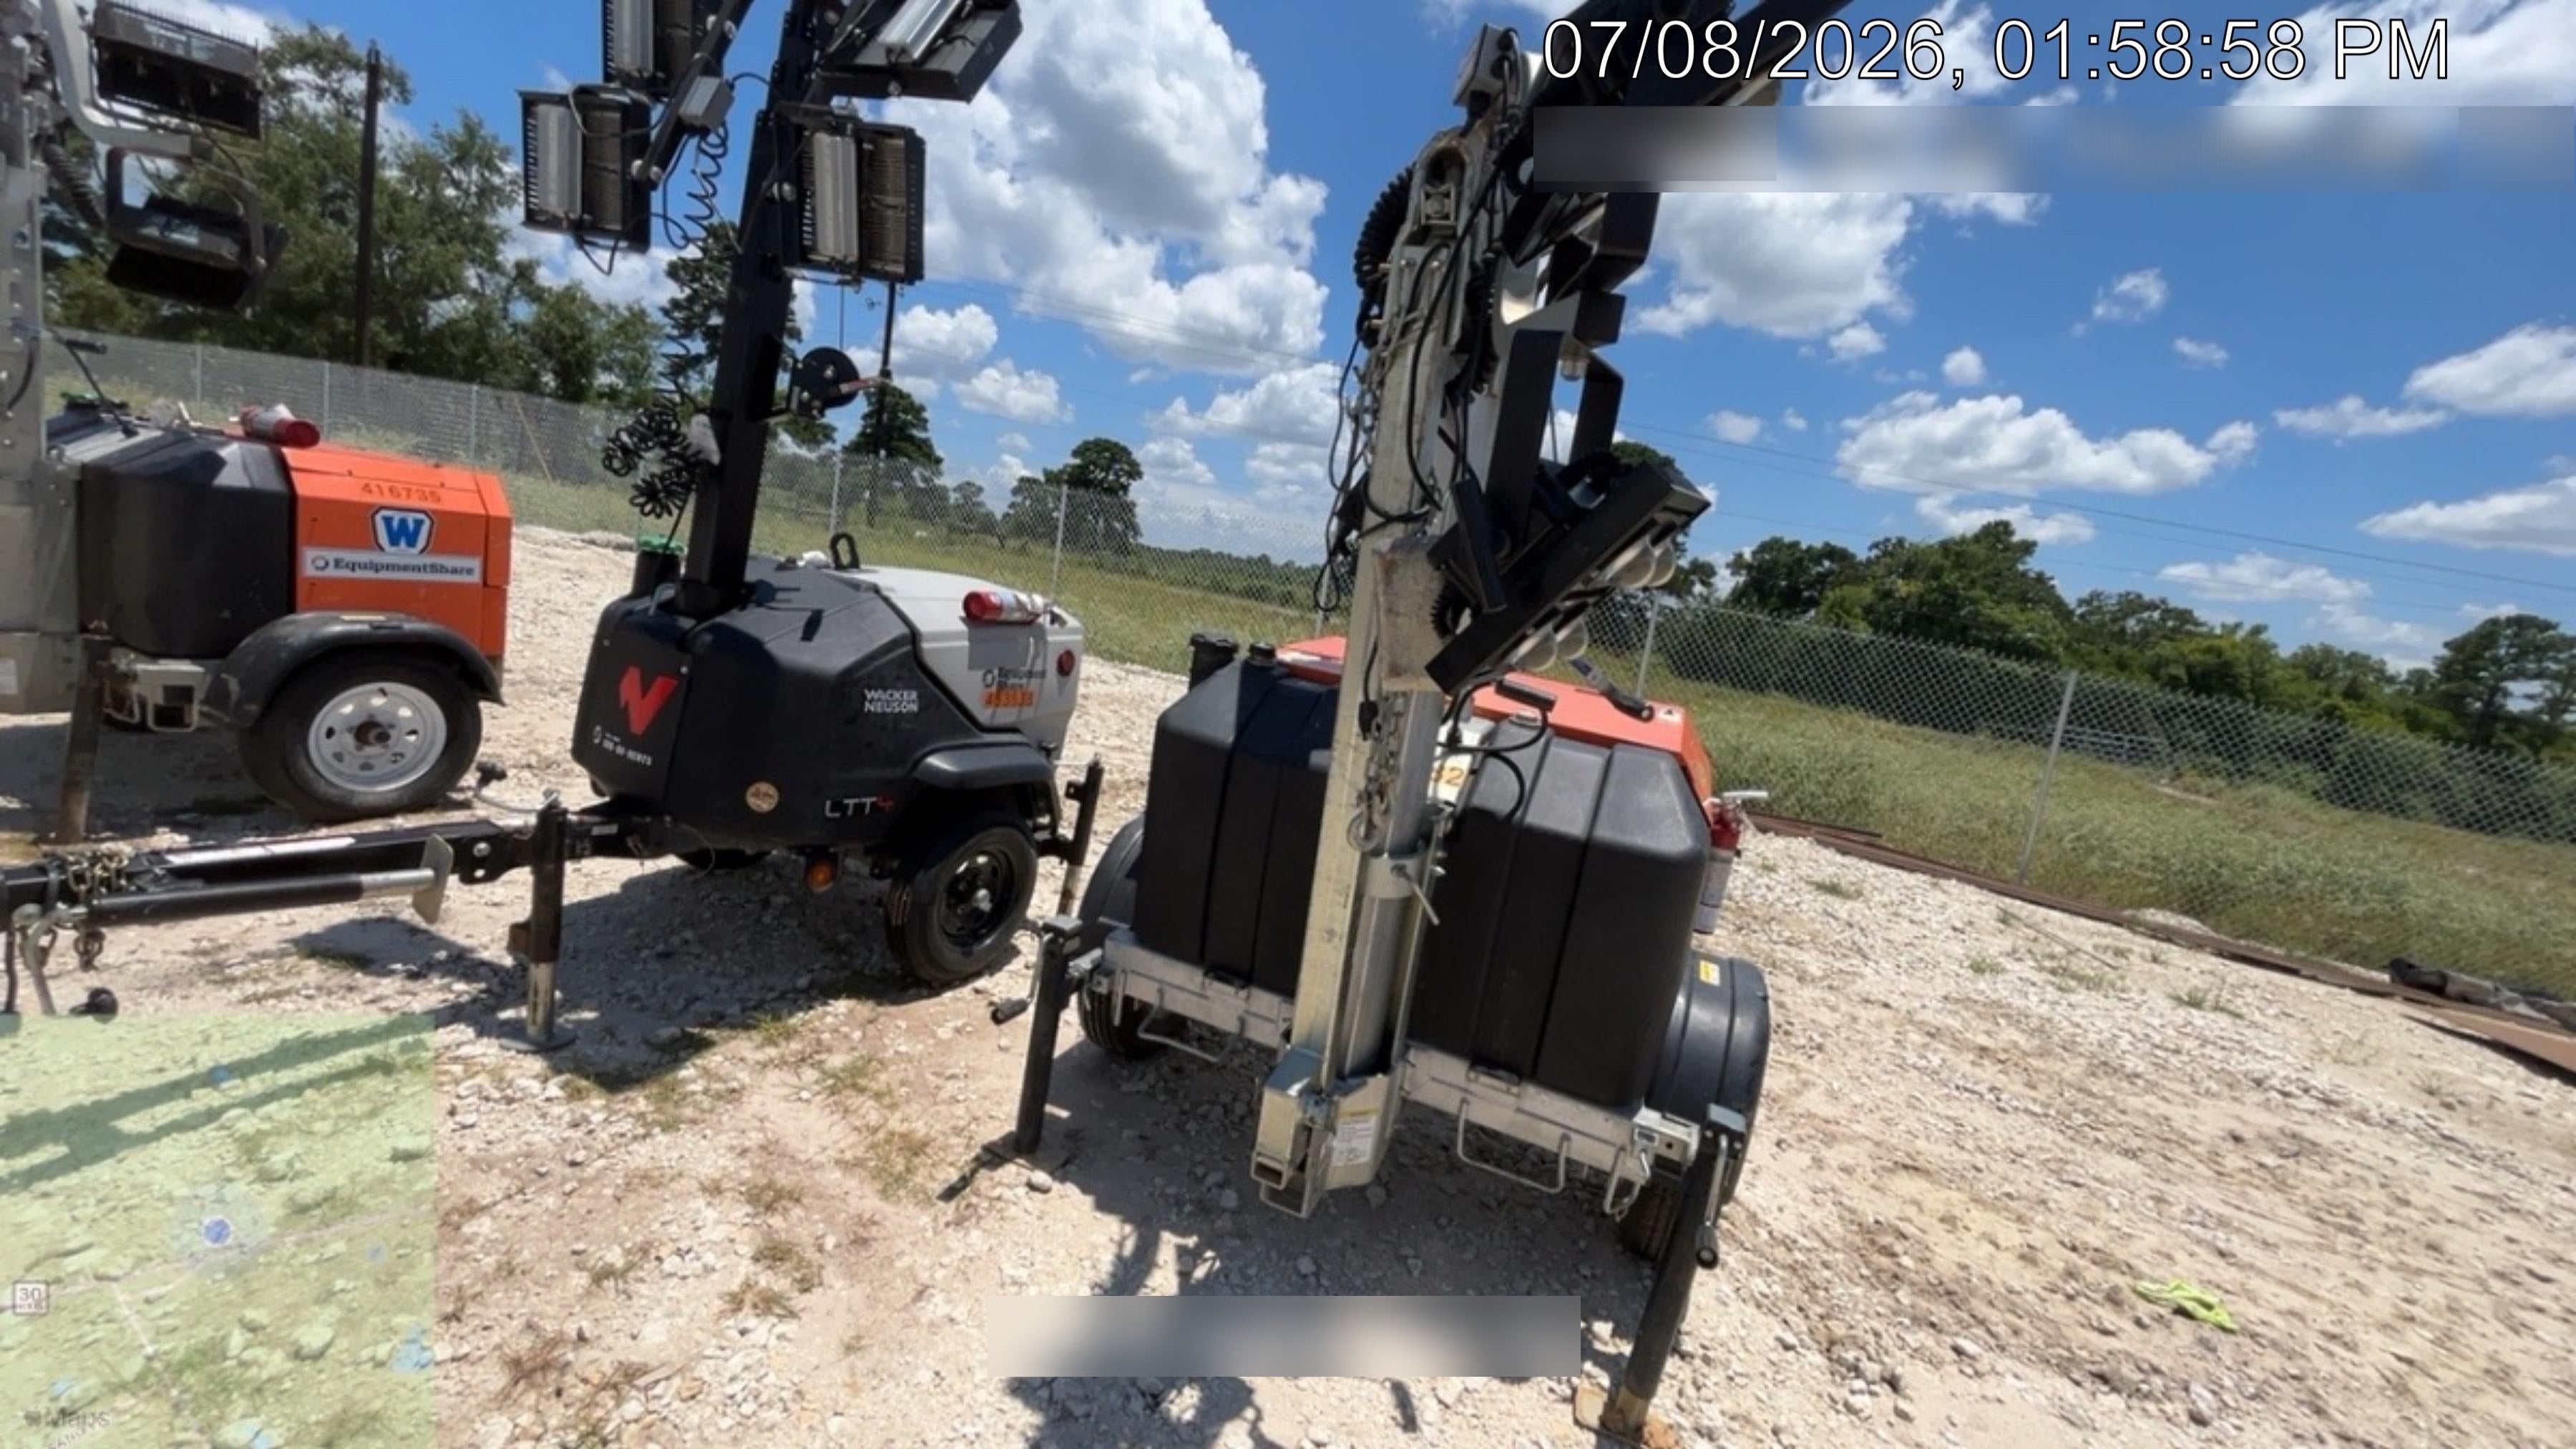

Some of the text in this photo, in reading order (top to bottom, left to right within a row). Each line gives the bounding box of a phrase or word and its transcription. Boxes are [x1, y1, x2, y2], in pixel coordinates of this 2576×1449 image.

[361, 482, 441, 502] 416735
[381, 514, 425, 548] W
[333, 557, 475, 576] EquipmentShare
[864, 688, 918, 701] WACKER
[864, 701, 919, 713] NEUSON
[825, 796, 894, 817] LTT4
